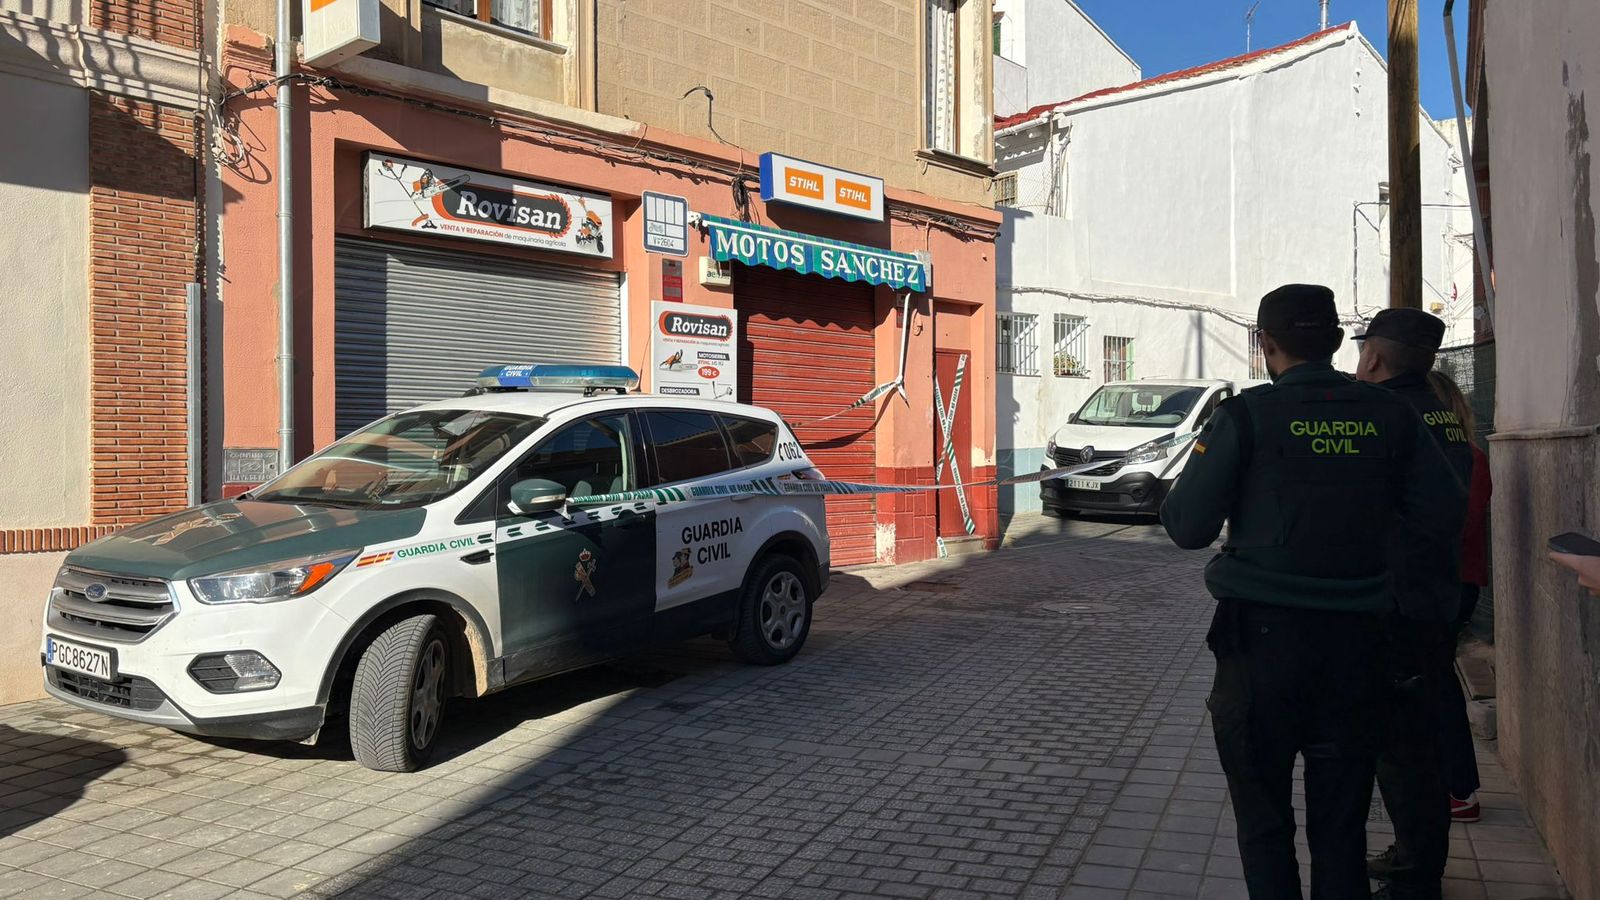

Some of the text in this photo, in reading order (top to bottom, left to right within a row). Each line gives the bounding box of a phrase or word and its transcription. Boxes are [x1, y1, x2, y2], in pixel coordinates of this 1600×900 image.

[788, 175, 868, 203] STIHL STIHL
[456, 190, 562, 230] Rovisan
[440, 224, 460, 232] VENTA
[466, 226, 504, 238] REPARACIÓN
[512, 235, 544, 245] maquinaria
[715, 229, 919, 284] MOTOS SANCHEZ
[671, 316, 727, 337] Rovisan
[1290, 420, 1378, 436] GUARDIA
[784, 440, 802, 459] 062
[1311, 438, 1360, 454] CIVIL
[682, 516, 743, 544] GUARDIA
[396, 537, 475, 558] GUARDIA CIVIL
[697, 542, 731, 565] CIVIL
[52, 641, 109, 677] PGC8627N
